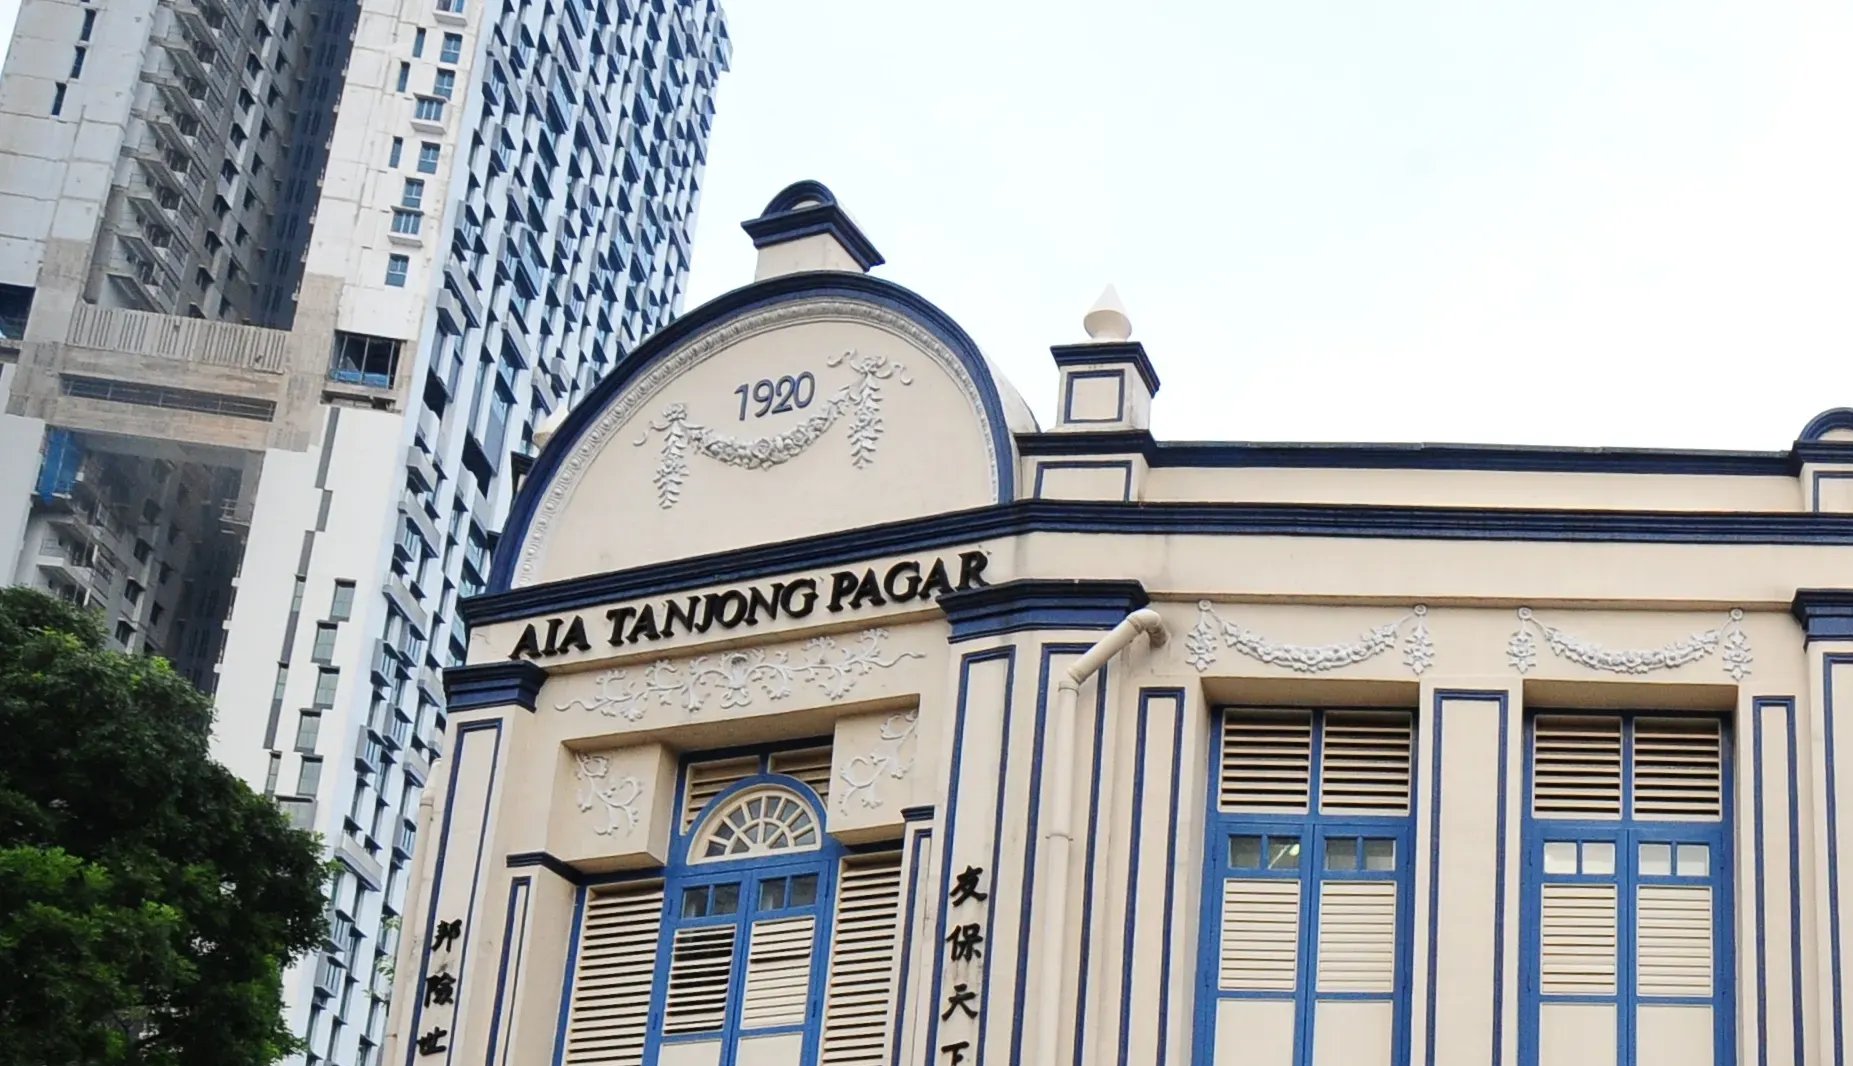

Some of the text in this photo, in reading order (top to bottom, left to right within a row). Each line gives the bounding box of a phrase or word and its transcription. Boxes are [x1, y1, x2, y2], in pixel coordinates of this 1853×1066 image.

[733, 371, 816, 421] 1920
[508, 550, 990, 660] AIA TANJONG PAGAR
